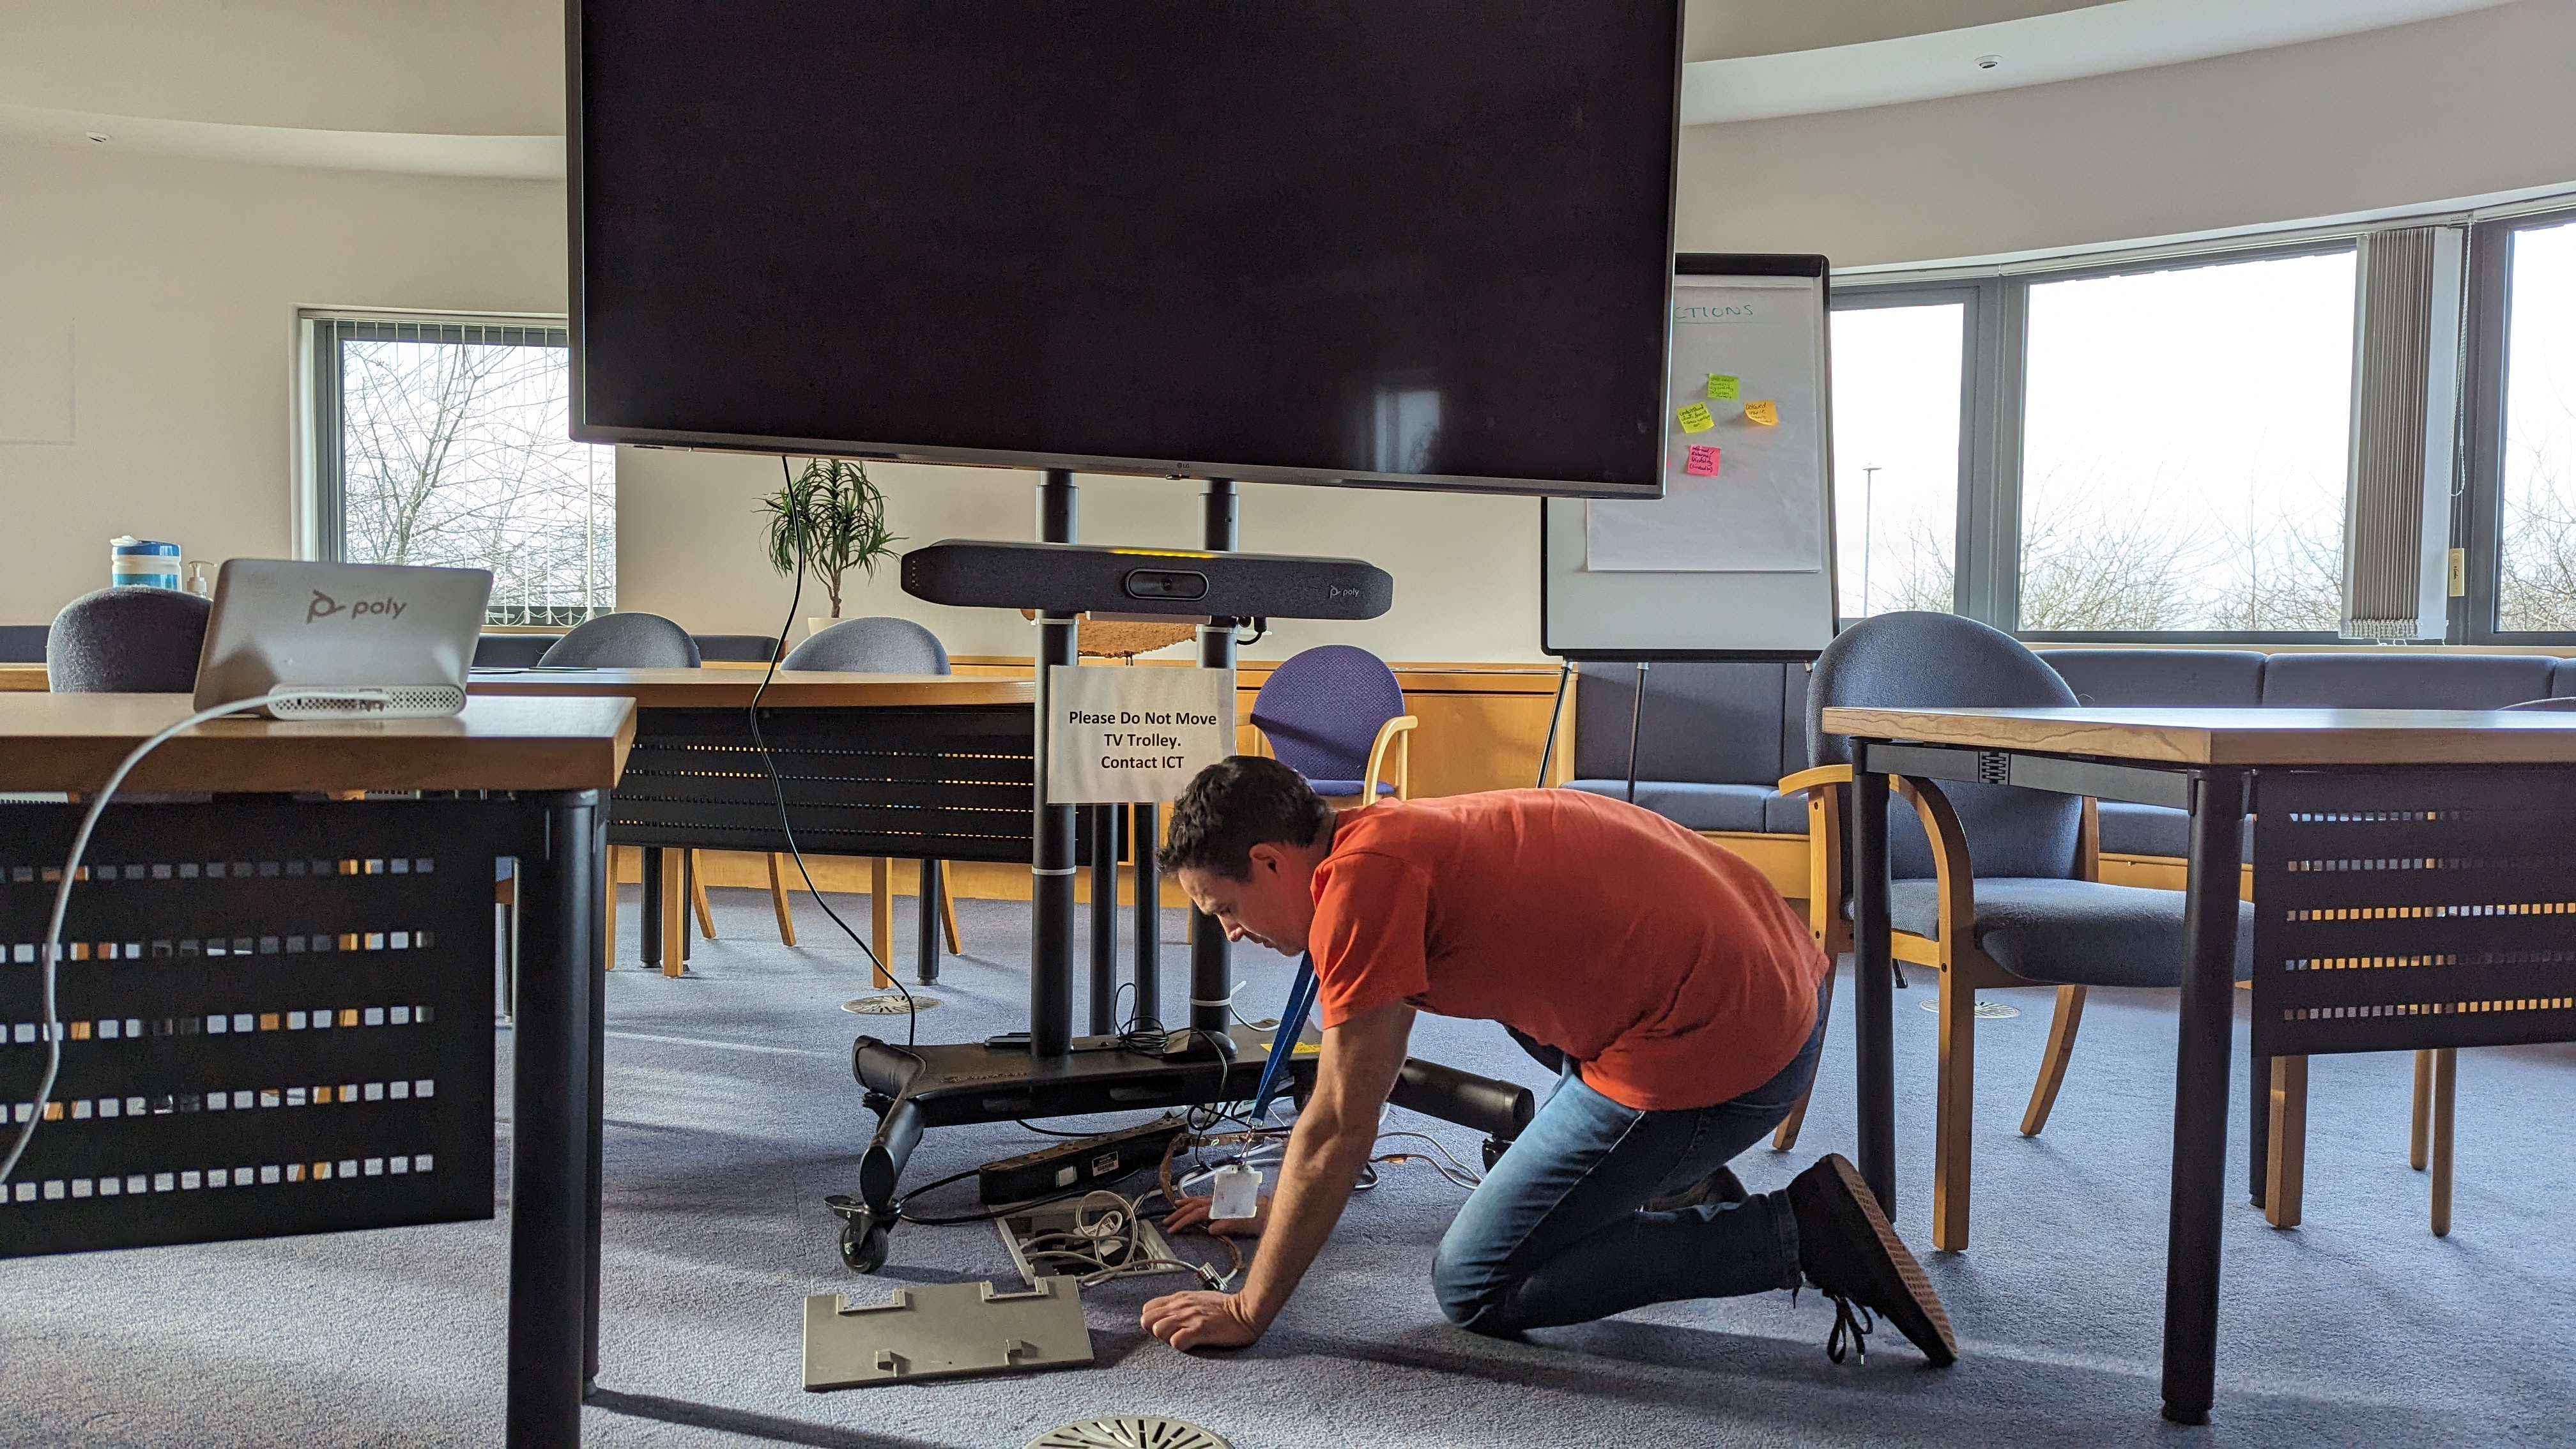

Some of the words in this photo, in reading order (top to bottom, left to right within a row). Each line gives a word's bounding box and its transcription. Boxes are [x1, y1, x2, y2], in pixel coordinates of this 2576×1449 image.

[1674, 304, 1753, 319] CTIONS
[1343, 588, 1360, 597] poly
[351, 597, 407, 620] poly
[1069, 711, 1116, 724] Please
[1121, 712, 1140, 724] Do
[1145, 712, 1172, 724] Not
[1176, 712, 1216, 725] Move
[1104, 734, 1123, 746] TV
[1127, 733, 1181, 749] Trolley.
[1101, 756, 1157, 769] Contact
[1162, 756, 1184, 769] ICT
